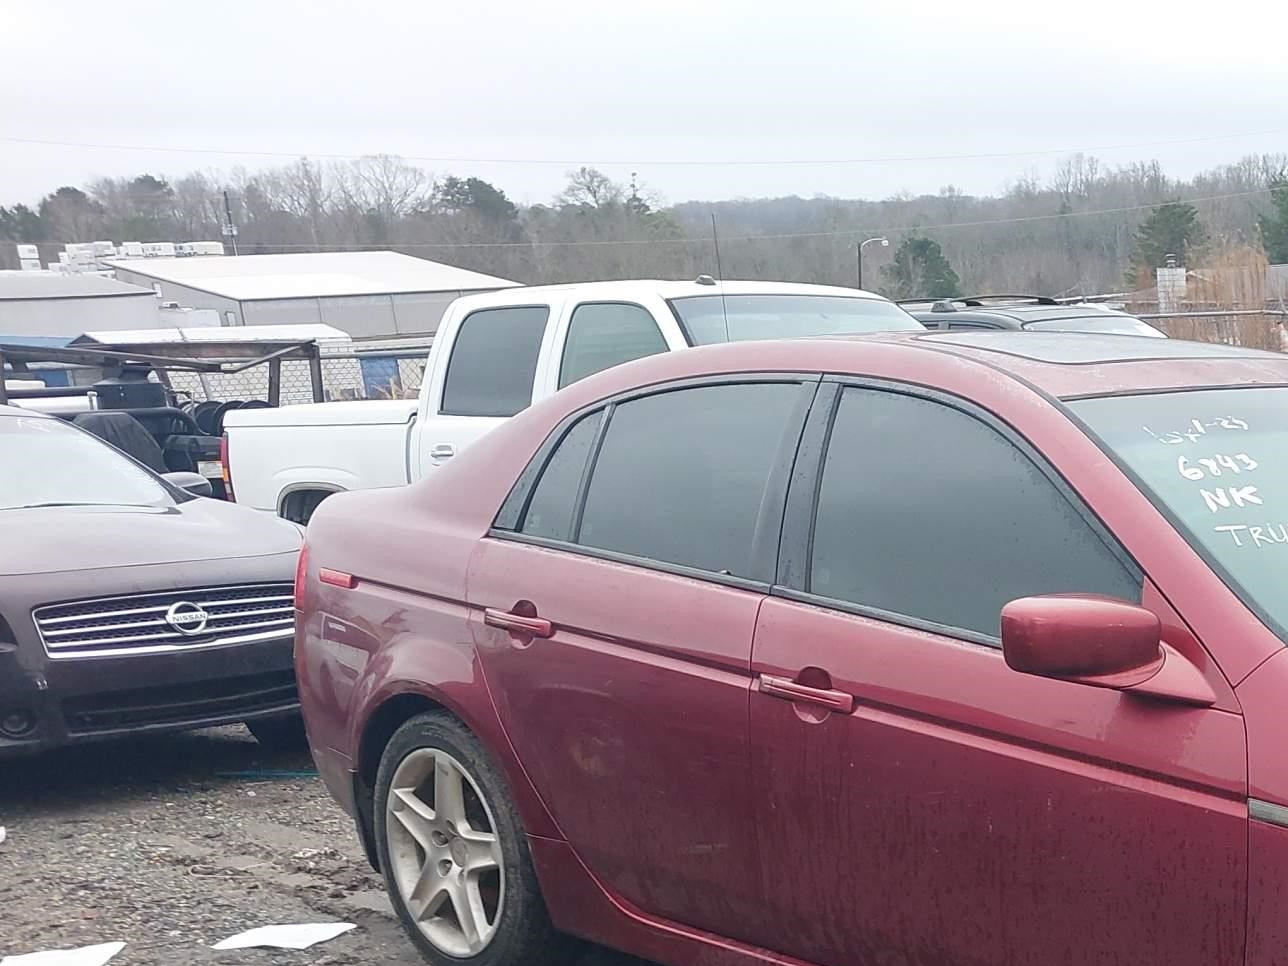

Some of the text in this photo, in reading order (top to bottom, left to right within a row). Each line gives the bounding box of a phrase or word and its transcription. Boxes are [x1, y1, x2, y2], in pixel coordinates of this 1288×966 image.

[1178, 453, 1258, 481] 6843
[1199, 485, 1263, 513] NK
[172, 613, 206, 621] NISSAN
